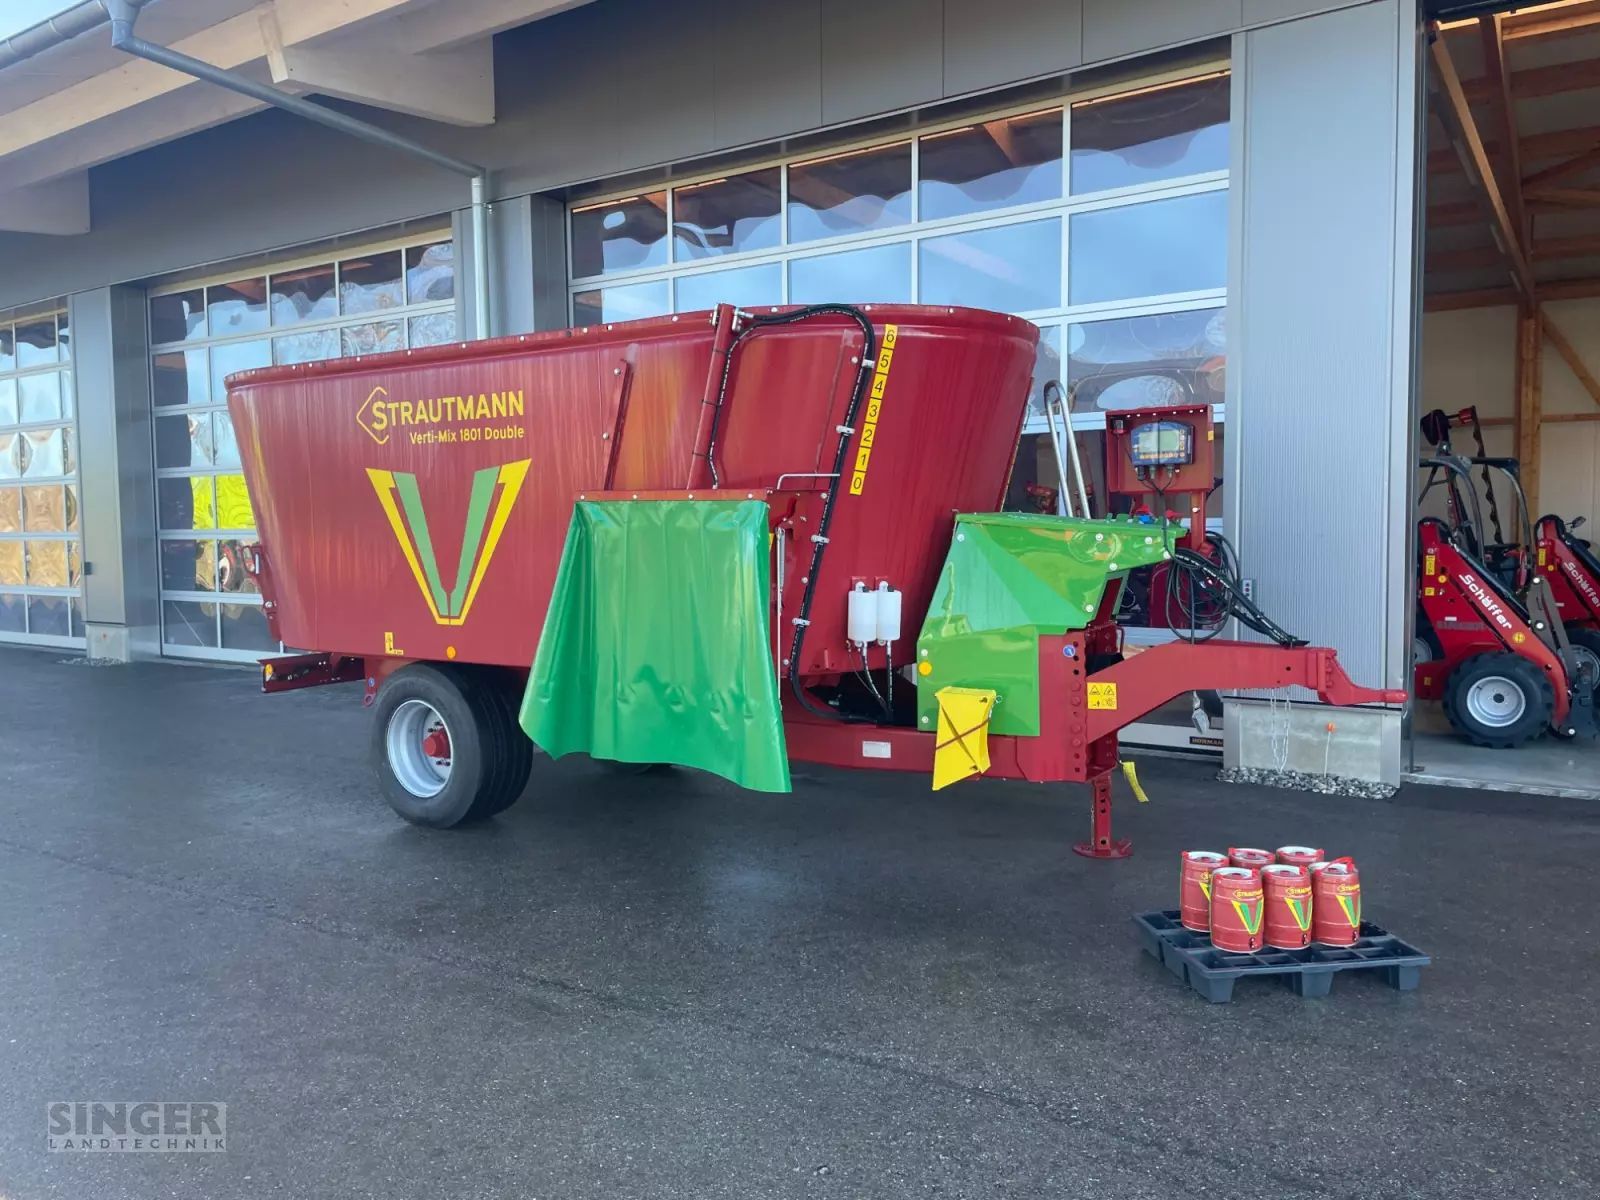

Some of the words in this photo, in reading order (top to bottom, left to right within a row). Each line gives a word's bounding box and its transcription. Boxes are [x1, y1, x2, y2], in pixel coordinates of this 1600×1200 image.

[372, 390, 524, 431] STRAUTMANN
[409, 431, 457, 445] Verti-Mix
[460, 428, 481, 442] 1801
[484, 425, 525, 440] Double
